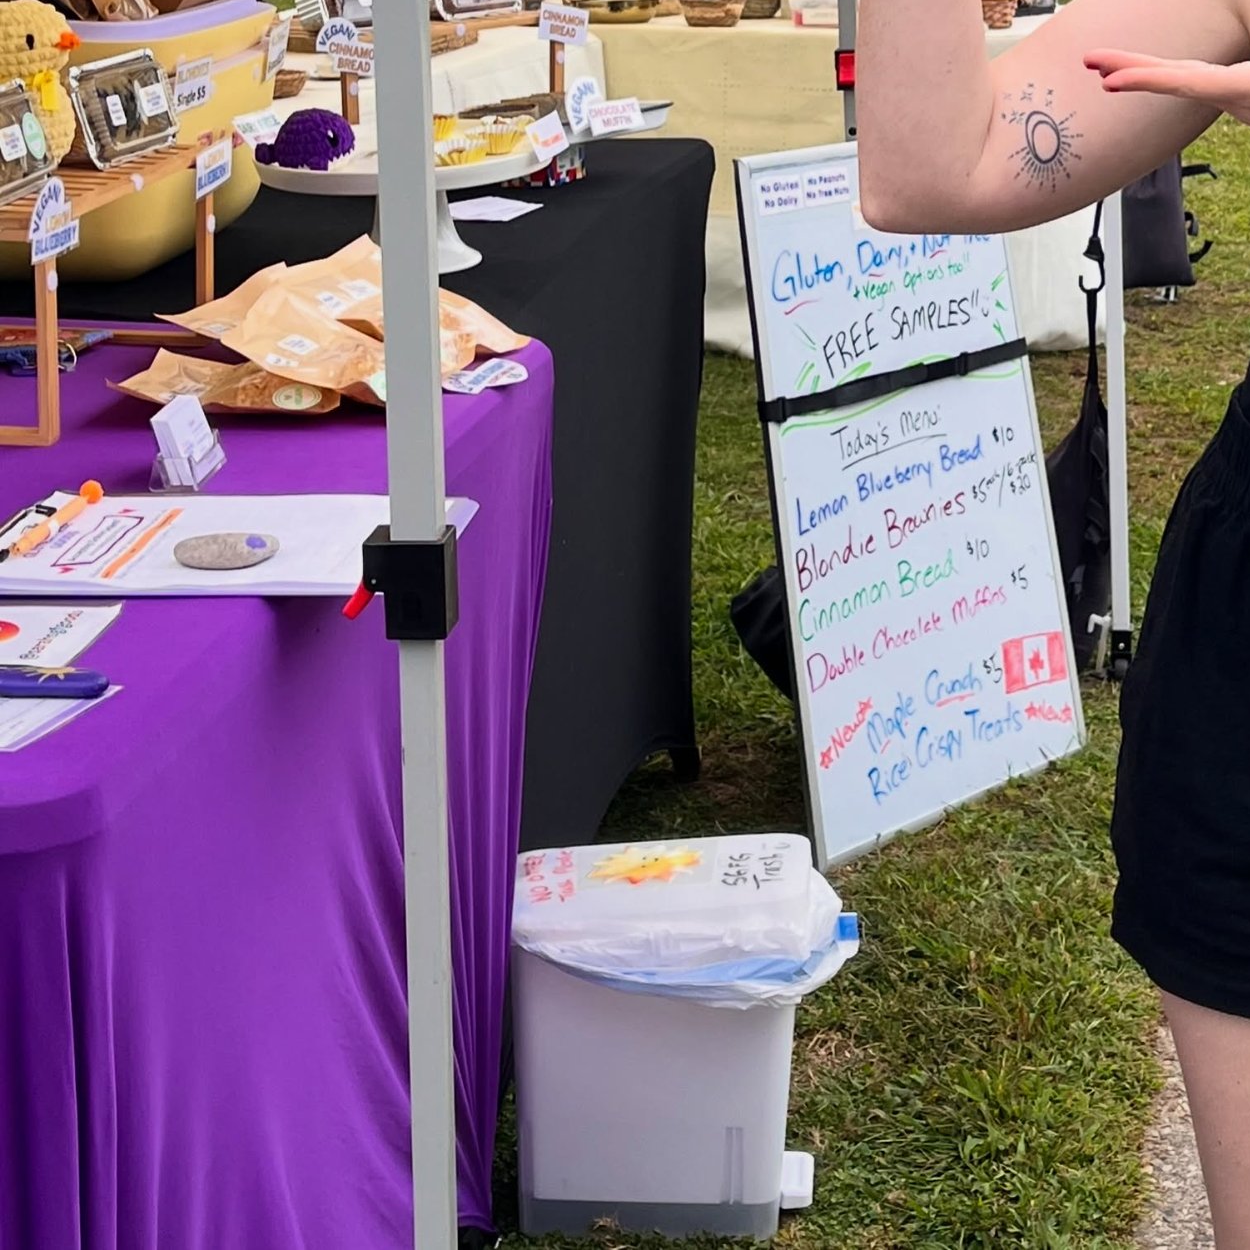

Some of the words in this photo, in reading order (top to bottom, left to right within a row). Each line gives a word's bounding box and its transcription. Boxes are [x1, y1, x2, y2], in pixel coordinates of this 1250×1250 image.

[542, 9, 585, 26] CINNAMON
[549, 23, 577, 39] BREAD
[329, 41, 375, 60] CINNAMO
[337, 57, 371, 73] BREAD
[177, 90, 197, 107] Single
[196, 85, 207, 102] $5
[588, 101, 637, 118] CHOCOLATE
[602, 114, 633, 129] MUFFIN
[760, 184, 771, 193] No
[773, 181, 799, 192] Gluten
[807, 177, 817, 185] No
[818, 173, 846, 184] Peanuts
[764, 199, 776, 209] No
[777, 196, 798, 208] Dairy
[806, 191, 816, 199] No
[818, 188, 832, 198] Tree
[834, 186, 850, 196] Nuts
[771, 249, 852, 302] Gluten,
[922, 234, 950, 257] Nut
[822, 311, 879, 379] FREE
[830, 421, 890, 460] Today's
[796, 493, 849, 536] Lemon
[856, 461, 933, 502] Blueberry
[939, 434, 984, 473] Bread
[992, 425, 1014, 447] $10
[795, 524, 877, 594] Blondie
[883, 491, 966, 549] Brownies
[798, 580, 892, 642] Cinnamon
[897, 548, 960, 599] Bread
[966, 533, 990, 562] $10
[806, 643, 865, 694] Double
[871, 612, 945, 660] Chocolate
[950, 585, 1008, 626] Muffins
[1011, 564, 1029, 590] $5
[866, 691, 917, 754] Maple
[924, 662, 983, 706] Crunch
[982, 651, 1004, 684] $5
[867, 761, 911, 807] Rice
[915, 726, 962, 769] Crispy
[964, 701, 1023, 743] Treats
[752, 852, 784, 890] Trash
